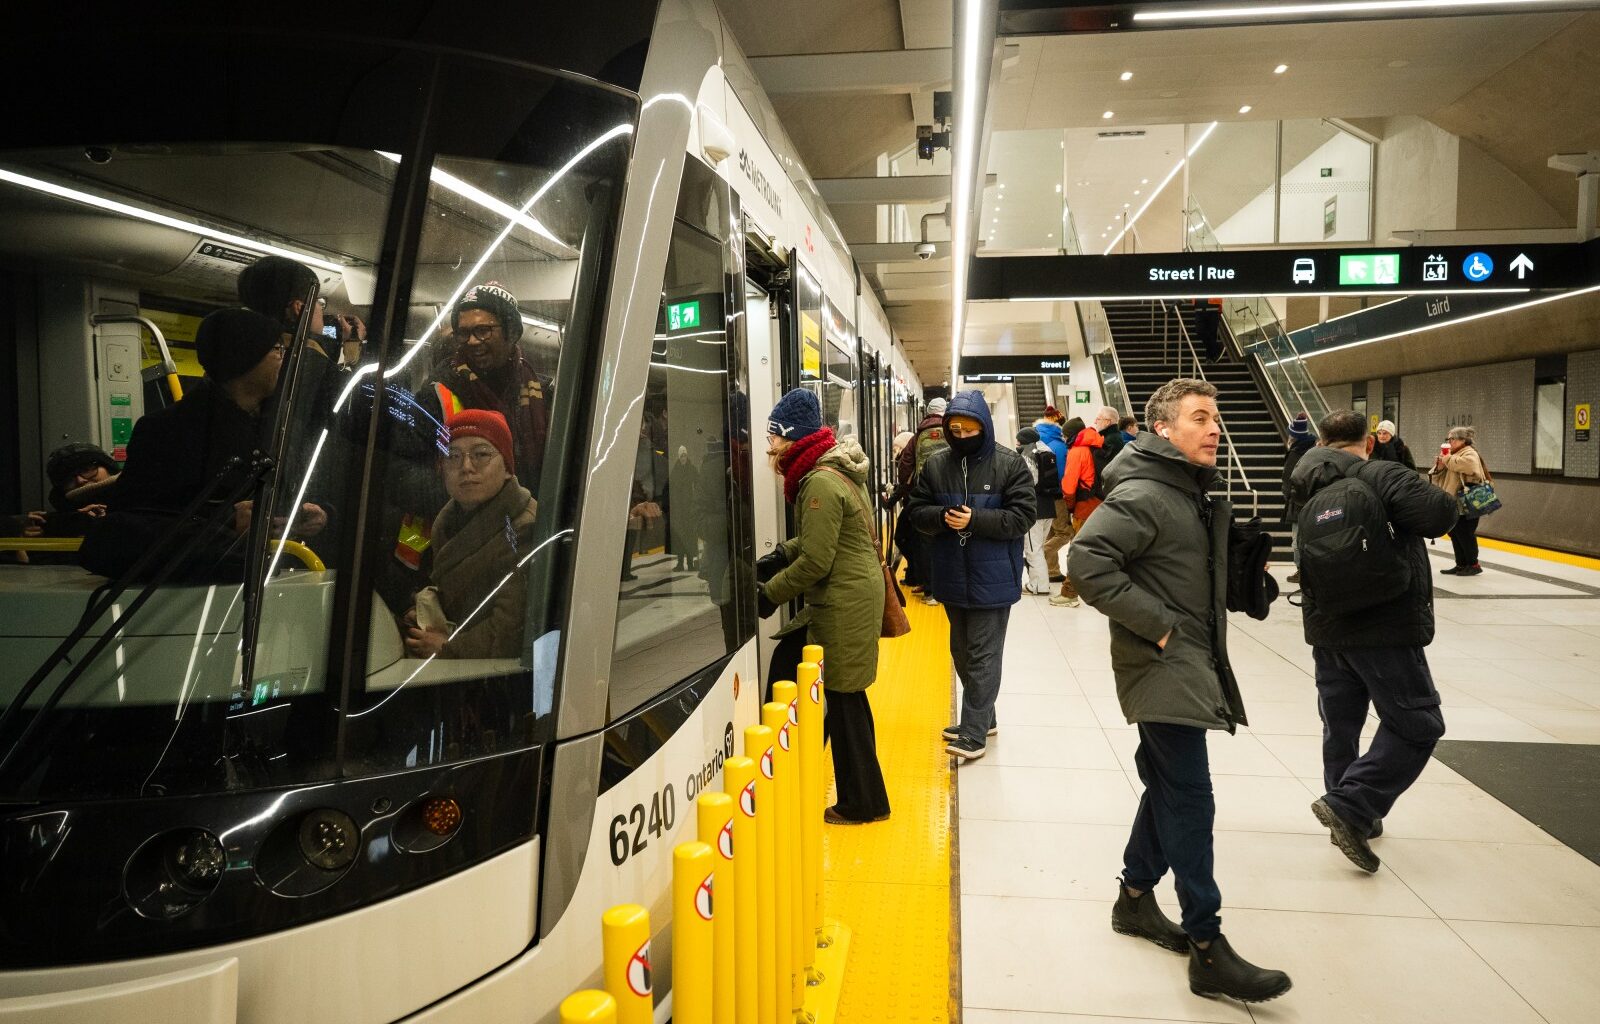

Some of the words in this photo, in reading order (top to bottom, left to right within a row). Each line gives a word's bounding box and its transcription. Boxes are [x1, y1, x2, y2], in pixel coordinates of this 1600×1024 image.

[1149, 267, 1195, 281] Street
[1207, 266, 1235, 280] Rue
[1425, 296, 1451, 317] Laird
[1040, 361, 1062, 369] Street
[1446, 414, 1473, 427] LAIRD
[686, 748, 724, 802] Ontario
[609, 783, 676, 867] 6240
